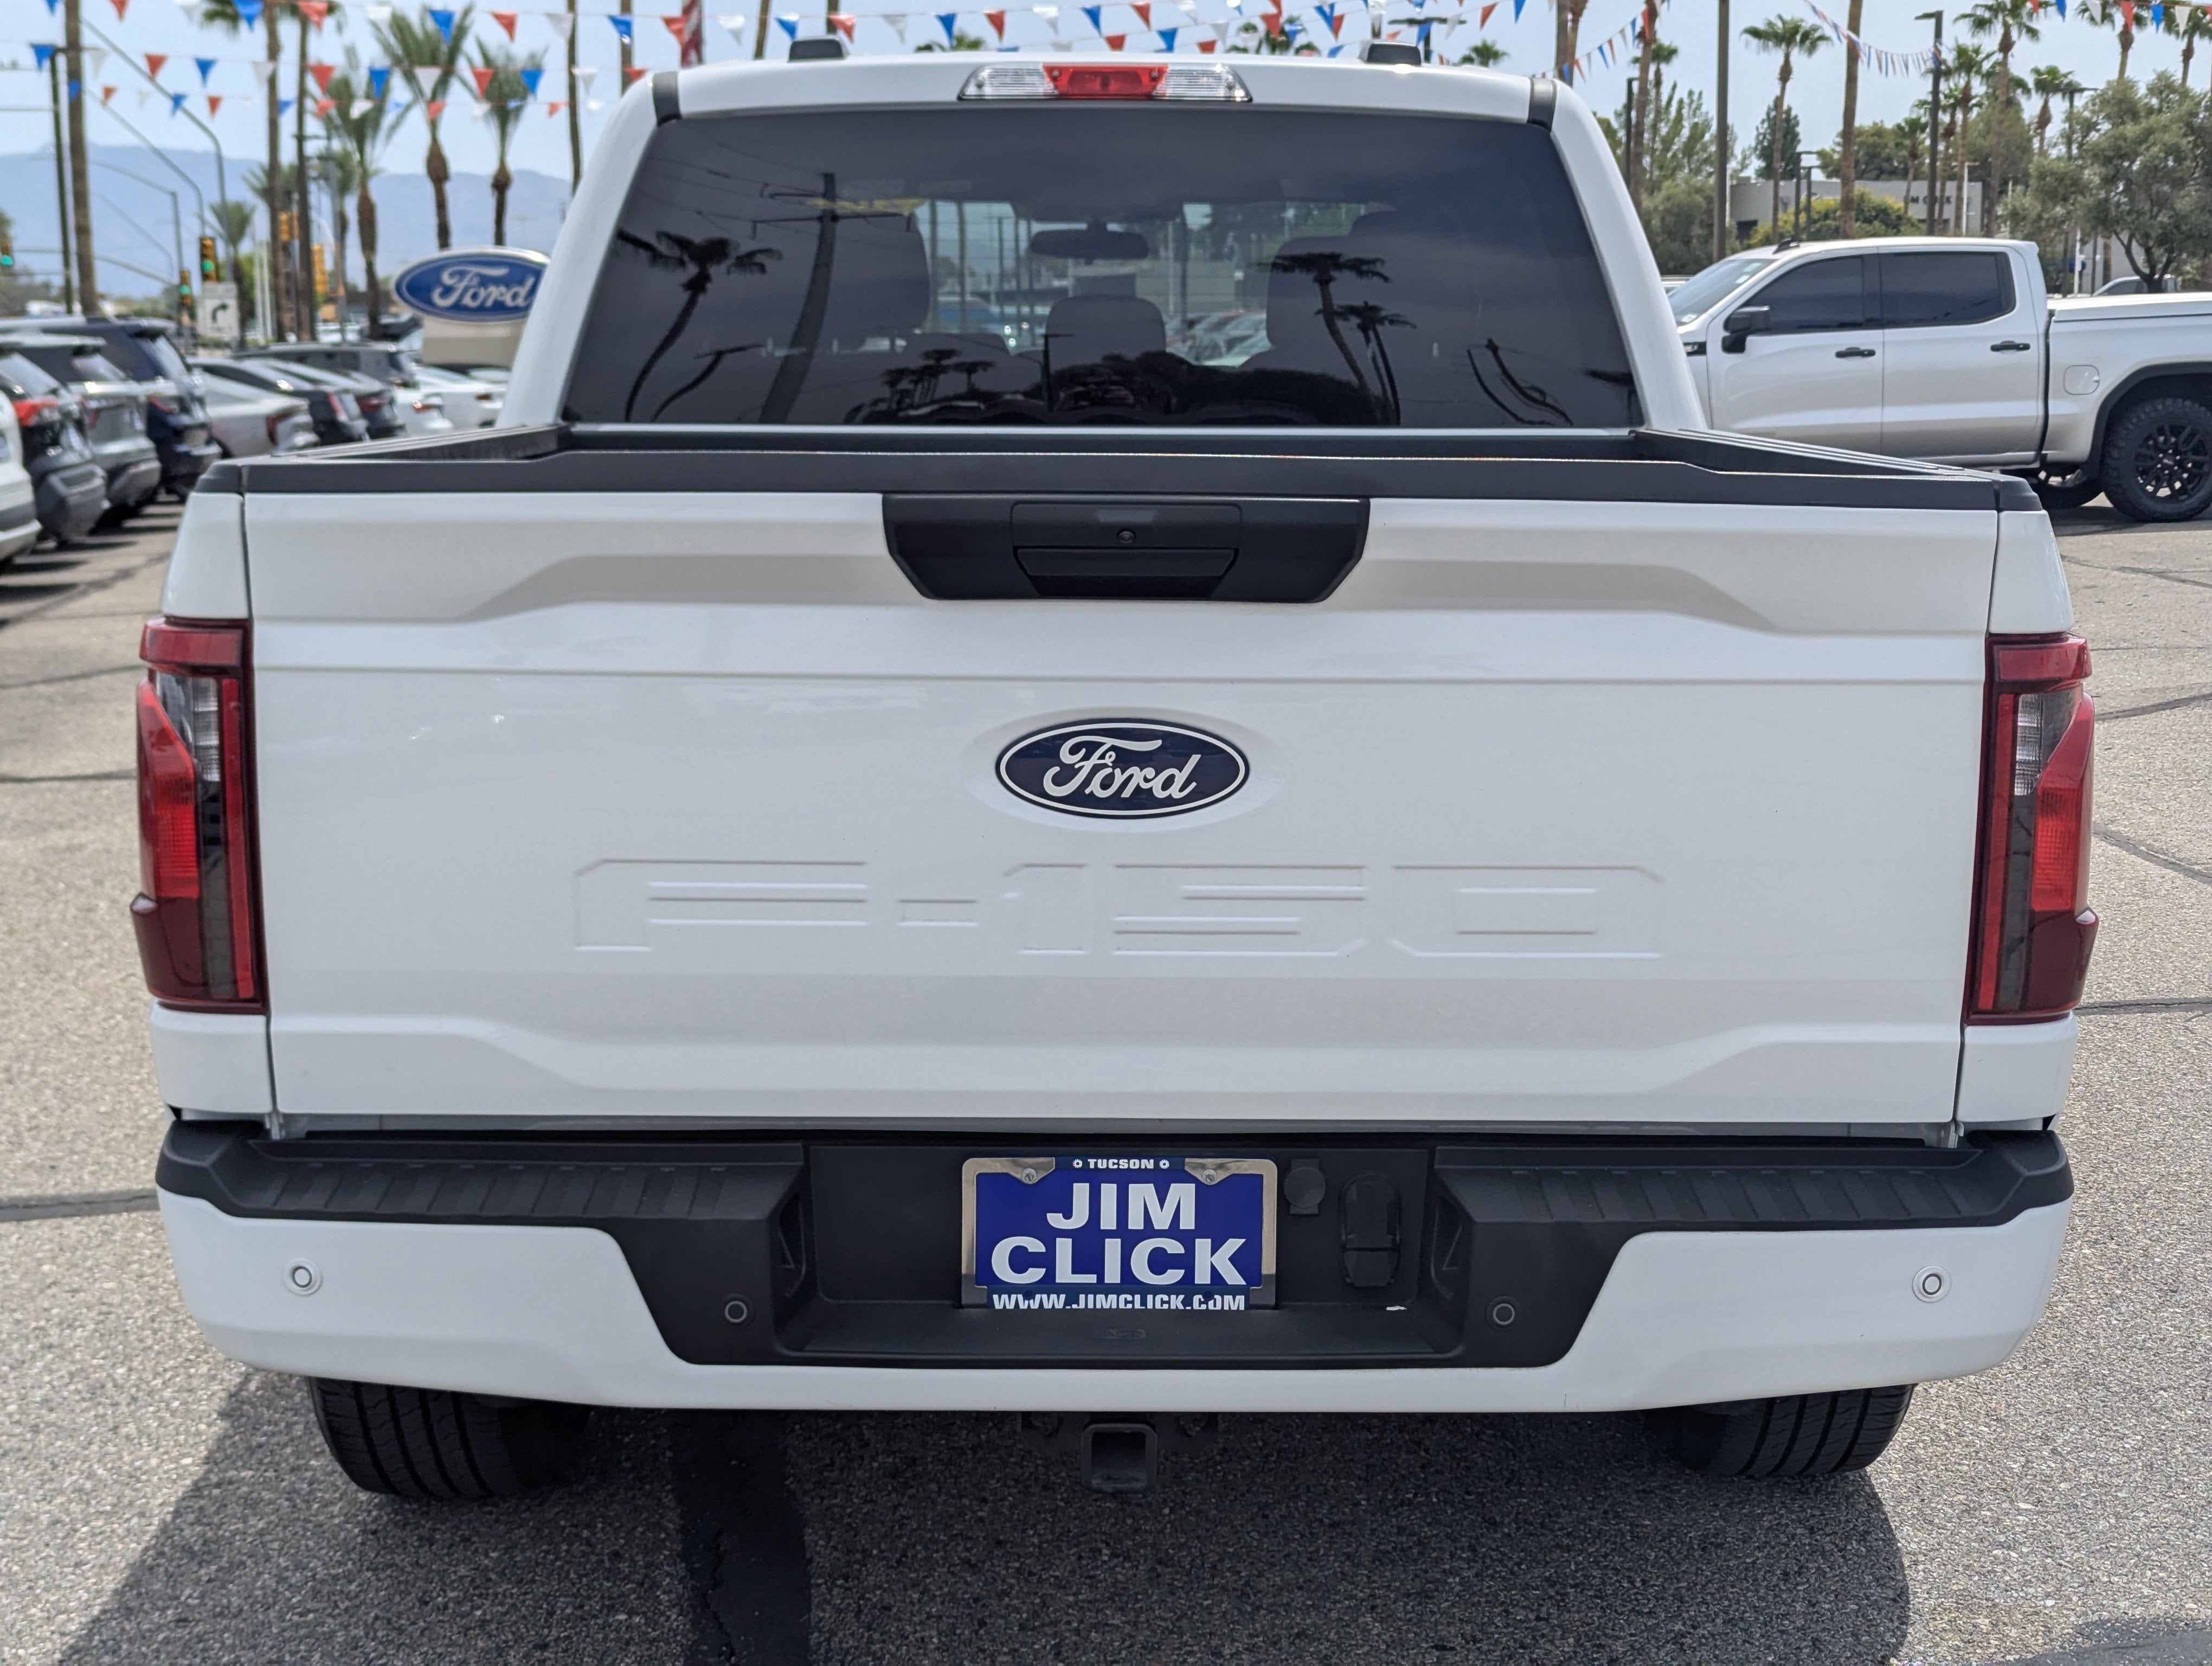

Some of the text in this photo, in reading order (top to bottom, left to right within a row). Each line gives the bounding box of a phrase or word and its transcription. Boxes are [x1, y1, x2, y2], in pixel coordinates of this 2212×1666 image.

[431, 266, 536, 307] Ford
[1043, 735, 1201, 798] Ford
[574, 859, 1666, 958] F-150
[1087, 1158, 1154, 1169] TUCSON
[1046, 1183, 1196, 1230] JIM
[991, 1236, 1247, 1285] CLICK
[993, 1293, 1245, 1311] WWW.JIMCLICK.COM
